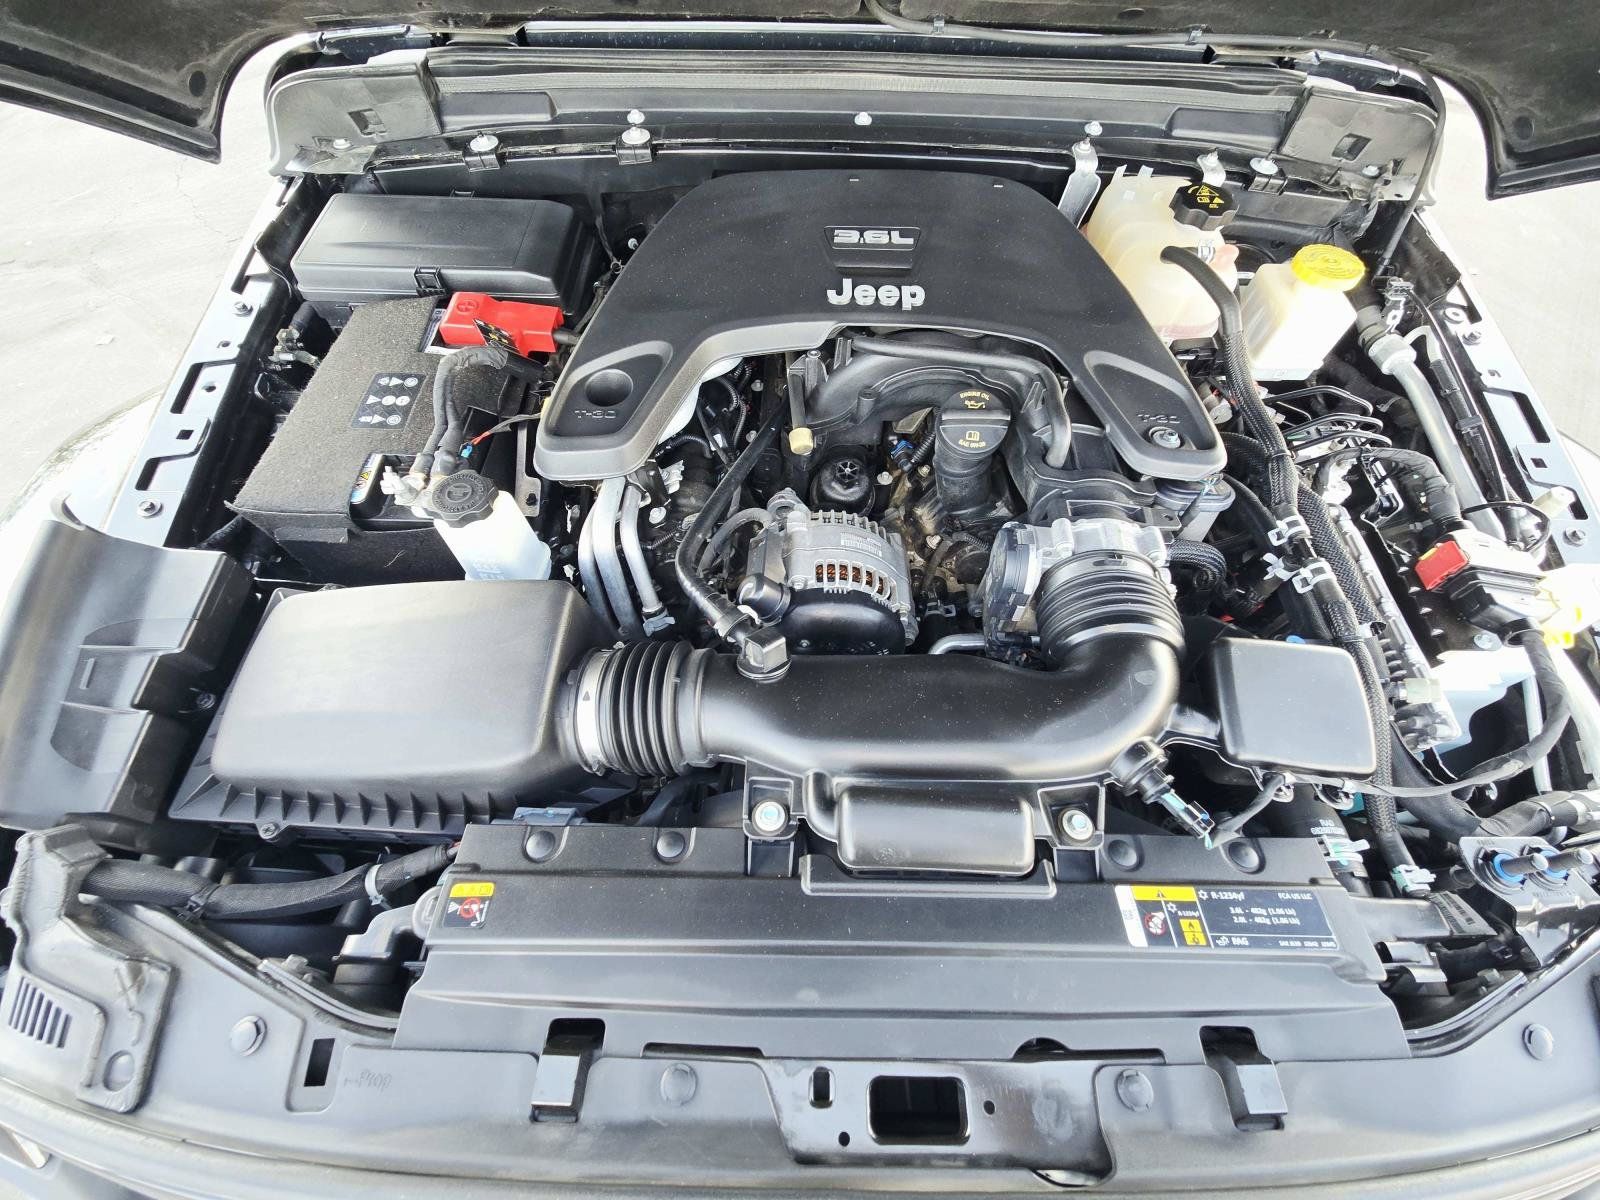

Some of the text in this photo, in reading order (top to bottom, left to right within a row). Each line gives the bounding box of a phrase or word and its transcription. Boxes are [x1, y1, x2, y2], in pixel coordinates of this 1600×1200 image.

[833, 229, 914, 245] 3.6L
[826, 278, 925, 311] Jeep
[981, 392, 989, 401] OIL
